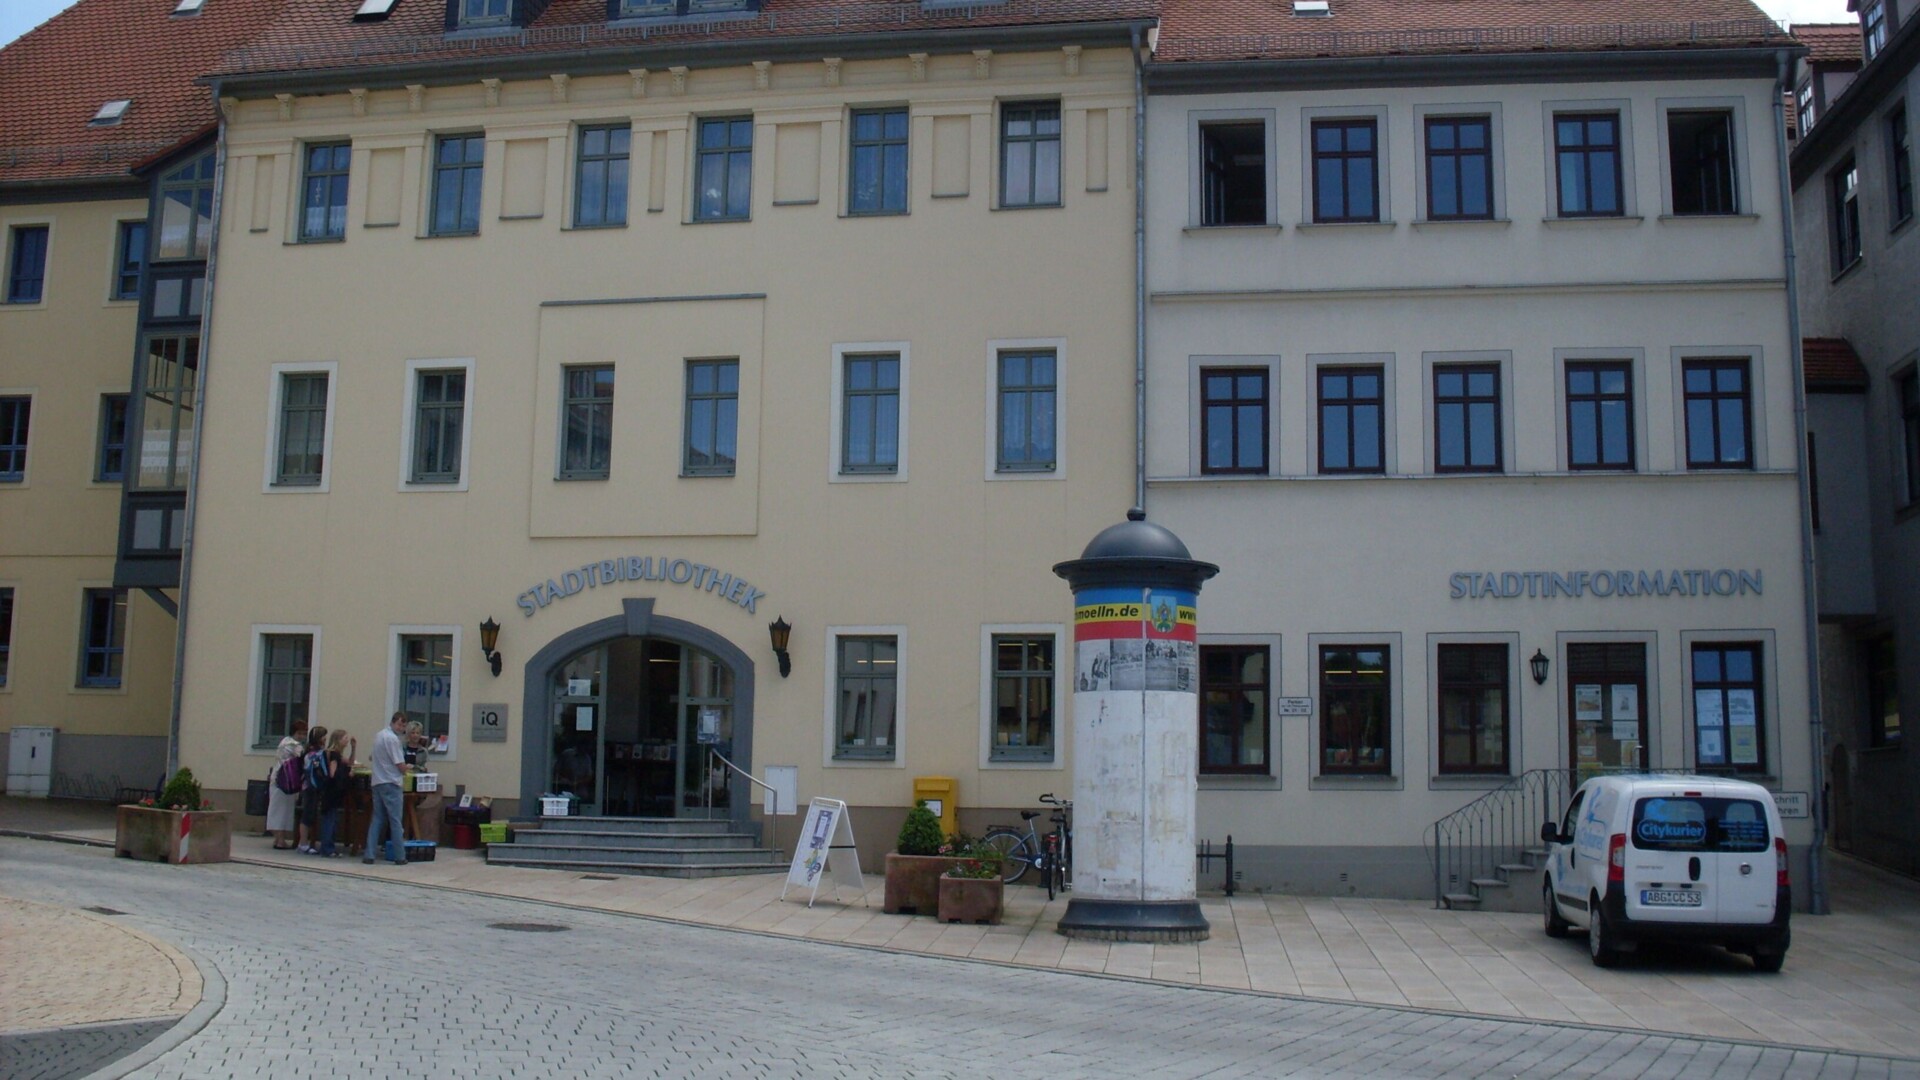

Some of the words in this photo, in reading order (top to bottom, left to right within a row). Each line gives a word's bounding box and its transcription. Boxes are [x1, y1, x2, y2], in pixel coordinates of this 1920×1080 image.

[516, 556, 766, 617] STADTBIBLIOTHEK
[1449, 569, 1763, 599] STADTINFORMATION
[481, 711, 498, 726] iQ
[1774, 795, 1799, 804] chritt
[1641, 823, 1703, 838] Citykurier
[1648, 892, 1667, 903] ABG
[1672, 892, 1686, 903] CC
